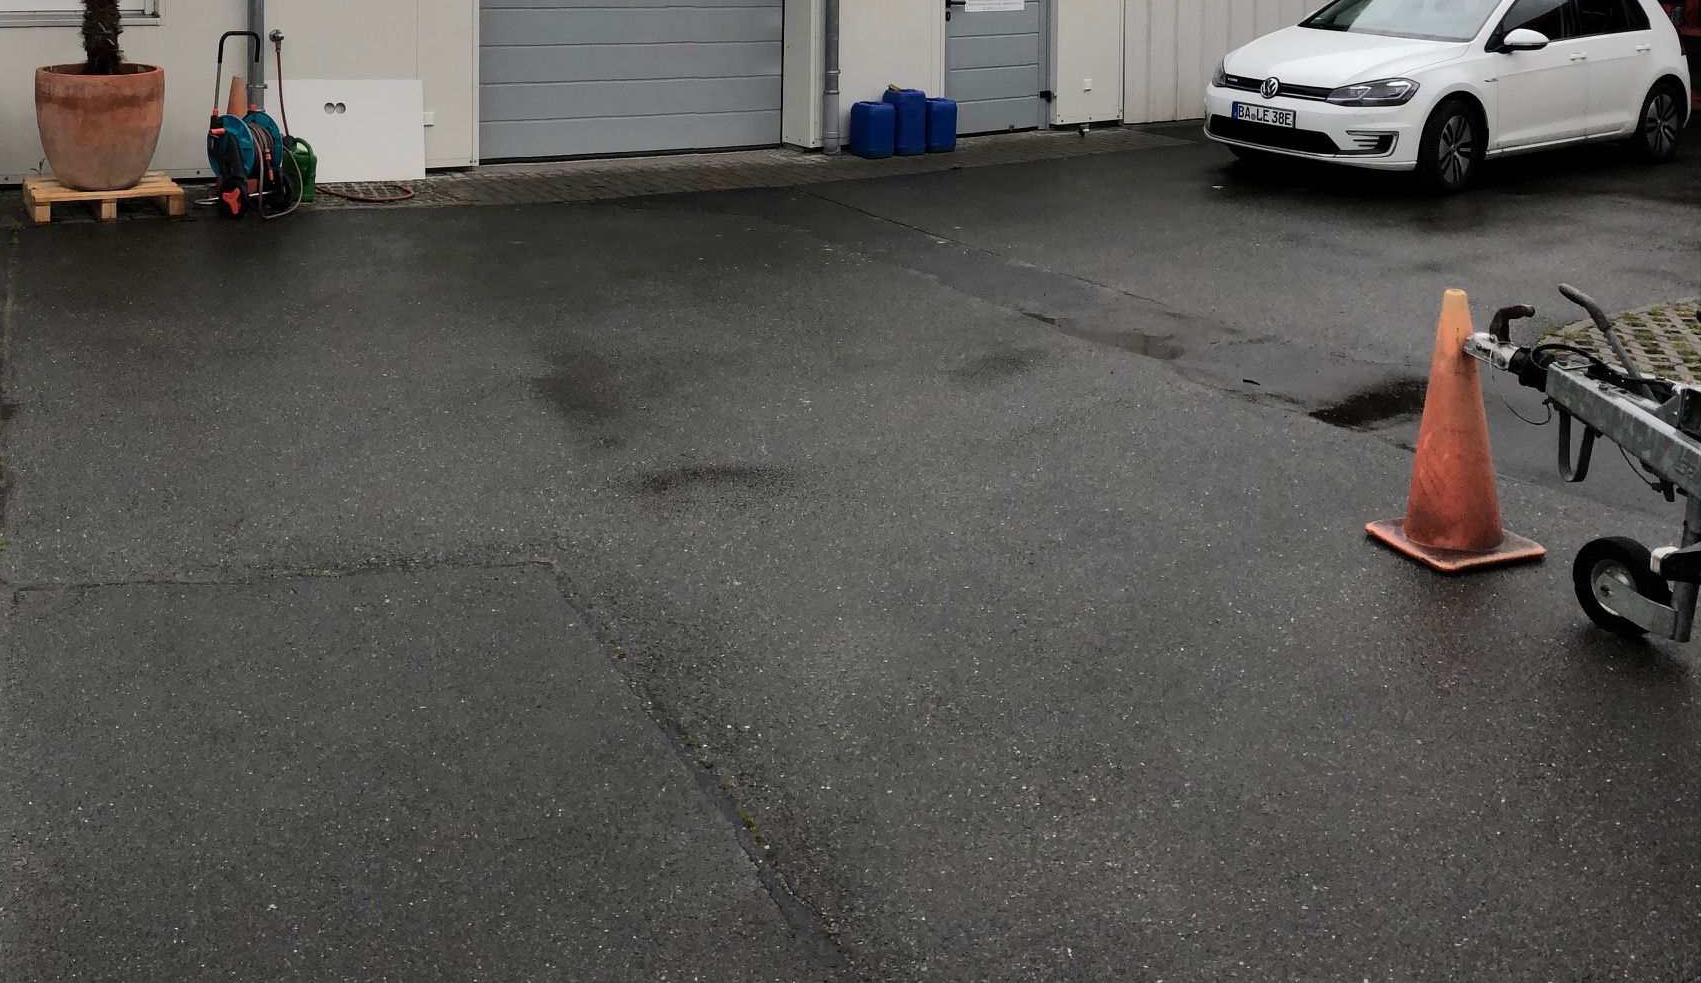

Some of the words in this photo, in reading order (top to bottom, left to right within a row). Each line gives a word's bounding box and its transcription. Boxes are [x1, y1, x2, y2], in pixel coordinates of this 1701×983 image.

[1238, 105, 1251, 120] BA
[1256, 108, 1270, 122] LE
[1272, 111, 1292, 126] 38E
